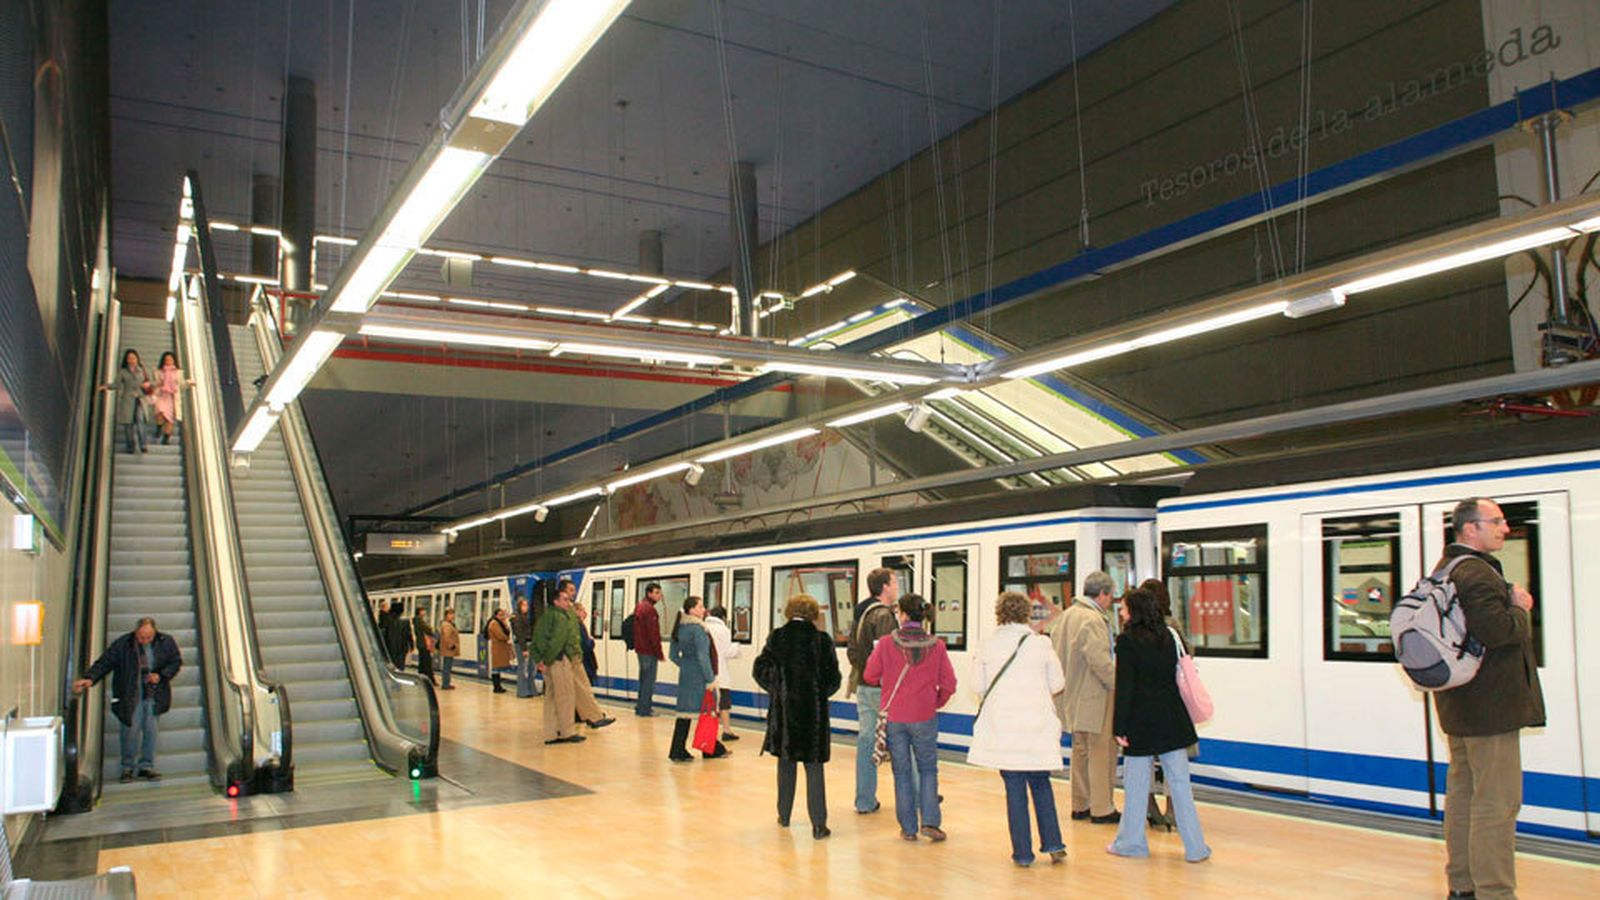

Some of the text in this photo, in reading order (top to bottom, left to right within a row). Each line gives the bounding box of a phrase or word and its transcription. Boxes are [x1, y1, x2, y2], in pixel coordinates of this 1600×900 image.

[1139, 24, 1561, 207] Tesoros de la alameda
